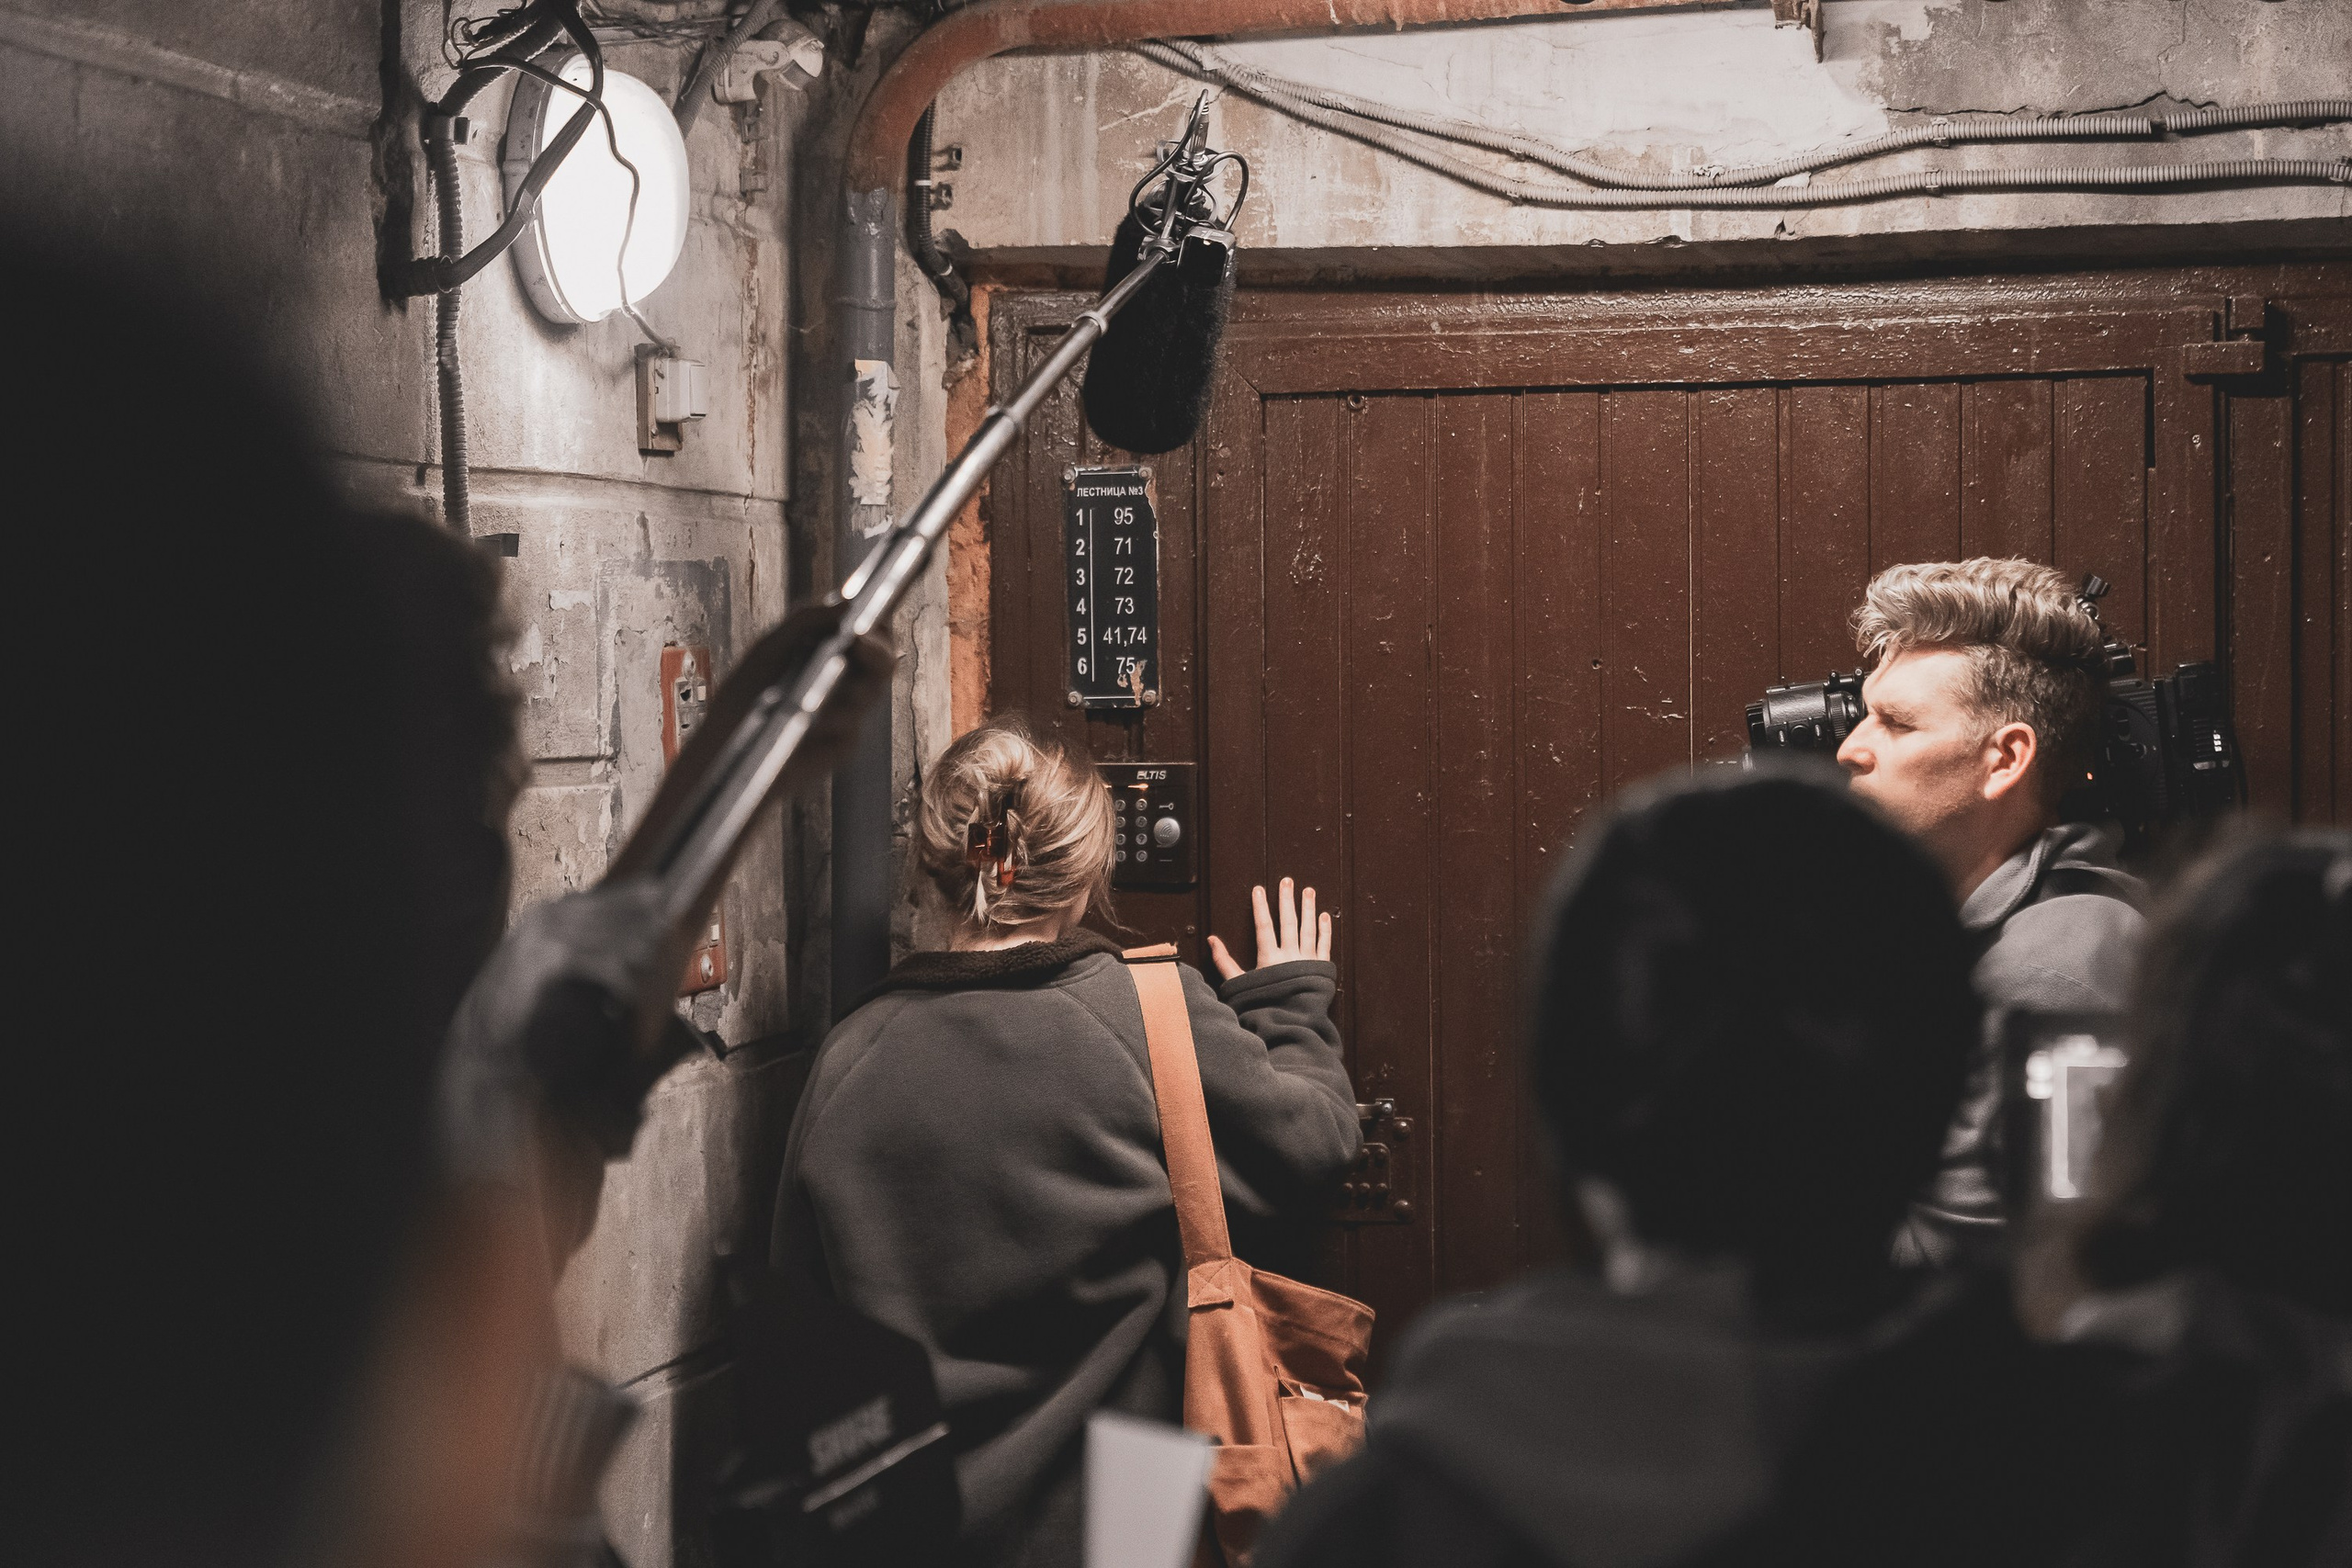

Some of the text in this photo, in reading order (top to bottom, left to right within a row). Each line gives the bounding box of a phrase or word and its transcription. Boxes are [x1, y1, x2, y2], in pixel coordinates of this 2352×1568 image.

[1076, 486, 1144, 497] ЛЕСТНИЦА №3
[1076, 507, 1133, 525] 1 95
[1076, 537, 1131, 555] 2 71
[1077, 567, 1133, 585] 3 72
[1076, 597, 1134, 615] 4 73
[1078, 626, 1147, 647] 5 41,74
[1078, 657, 1136, 675] 6 75
[1136, 770, 1167, 780] ELTIS
